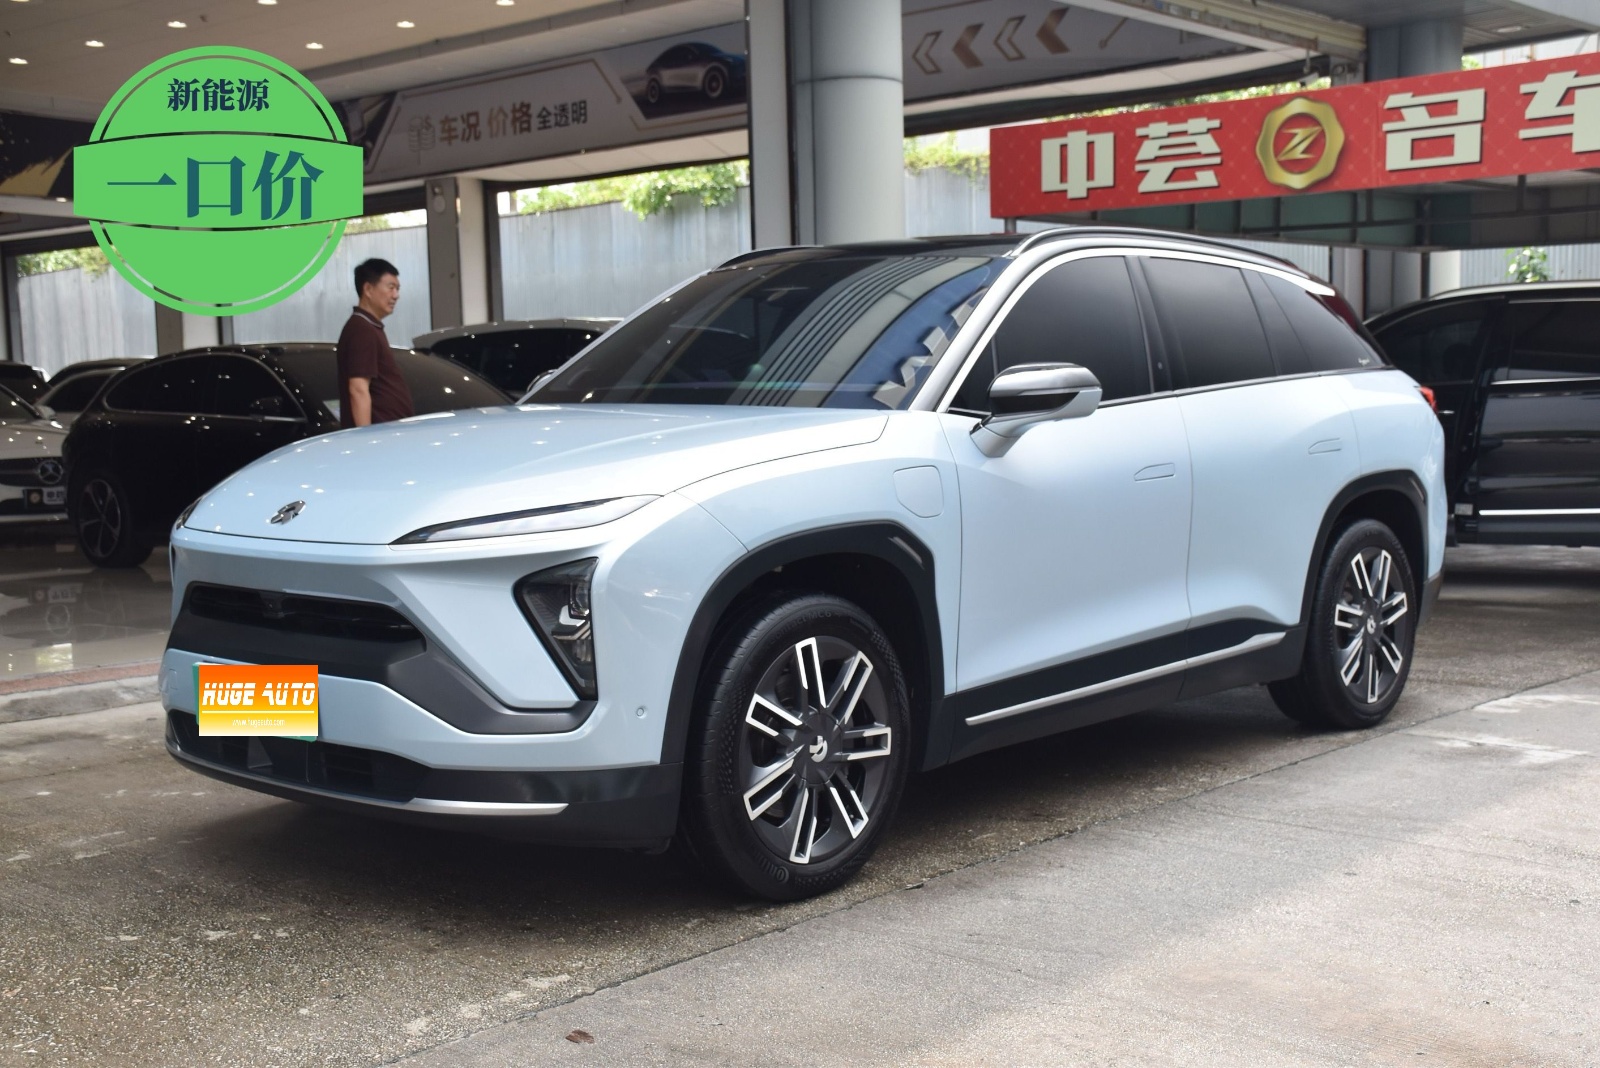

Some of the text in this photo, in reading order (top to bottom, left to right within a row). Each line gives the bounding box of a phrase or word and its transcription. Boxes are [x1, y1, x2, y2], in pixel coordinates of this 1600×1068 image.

[439, 100, 588, 146] 车况 价格 全透明
[1041, 117, 1222, 199] 中荟
[1383, 69, 1600, 171] 名车
